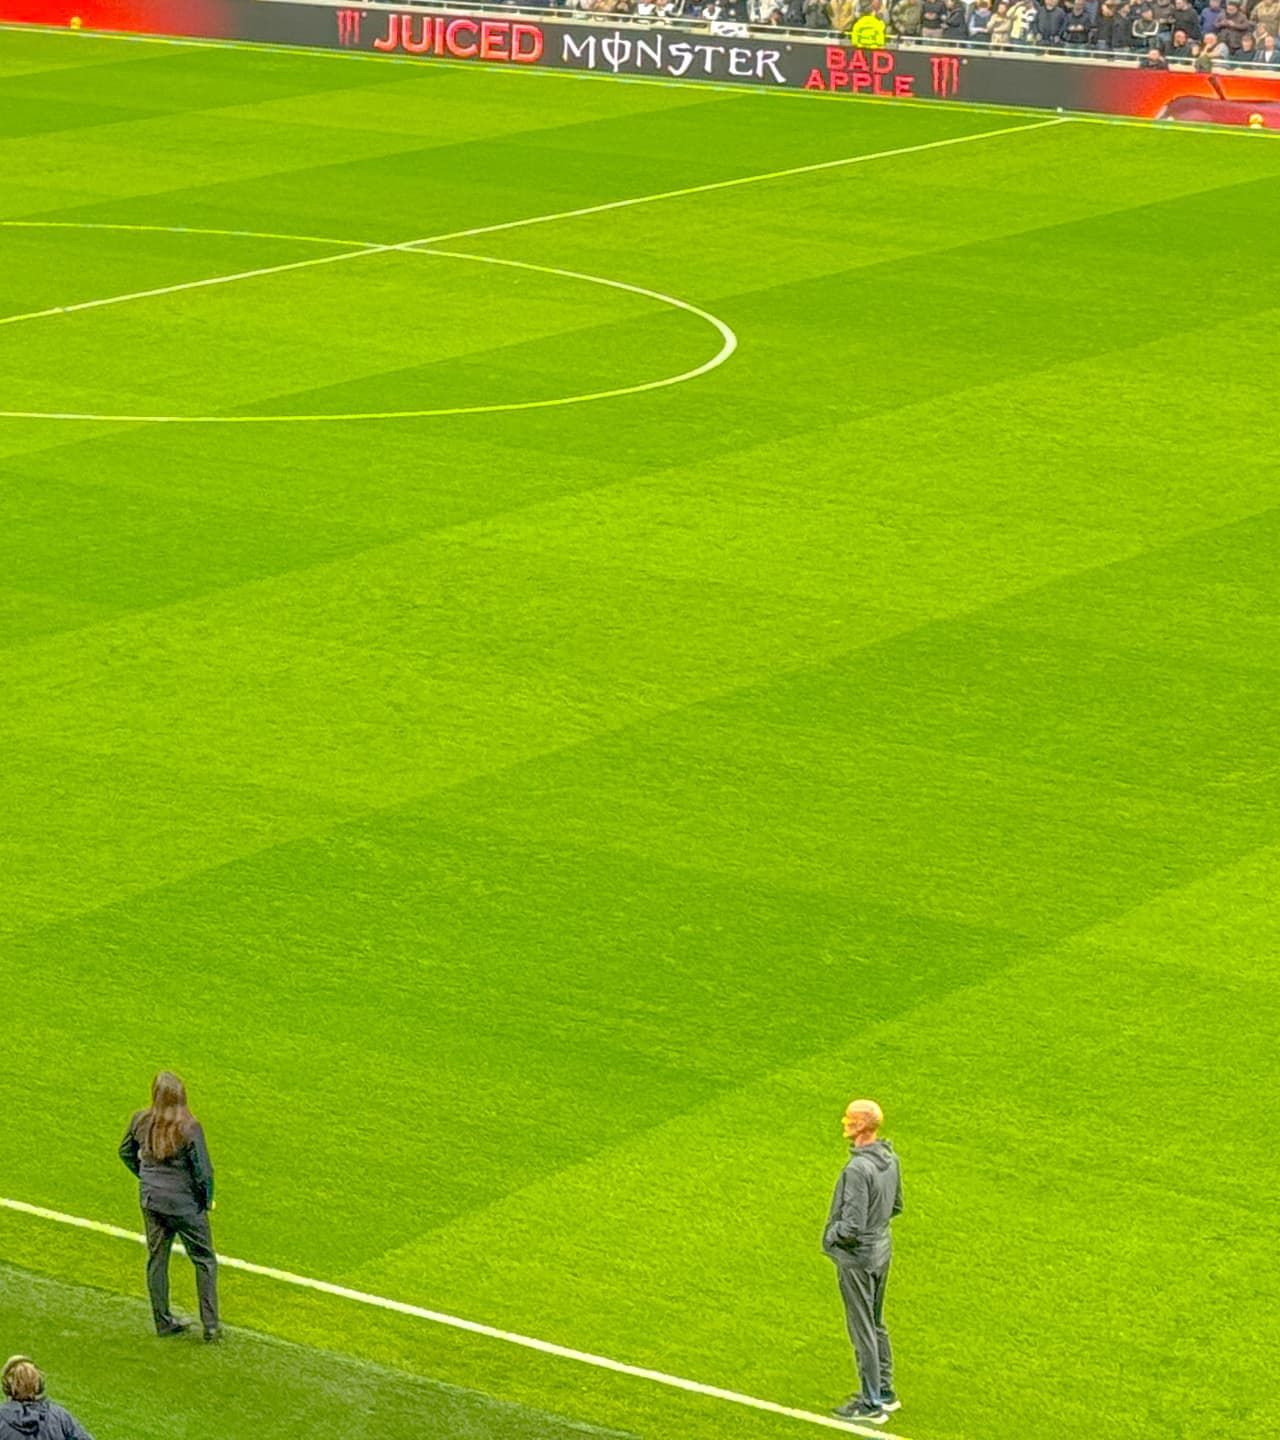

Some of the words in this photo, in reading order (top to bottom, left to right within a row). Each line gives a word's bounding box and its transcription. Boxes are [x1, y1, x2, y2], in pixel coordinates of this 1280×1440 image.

[373, 12, 544, 63] JUICED
[825, 46, 896, 75] BAD
[804, 68, 916, 99] APPLE
